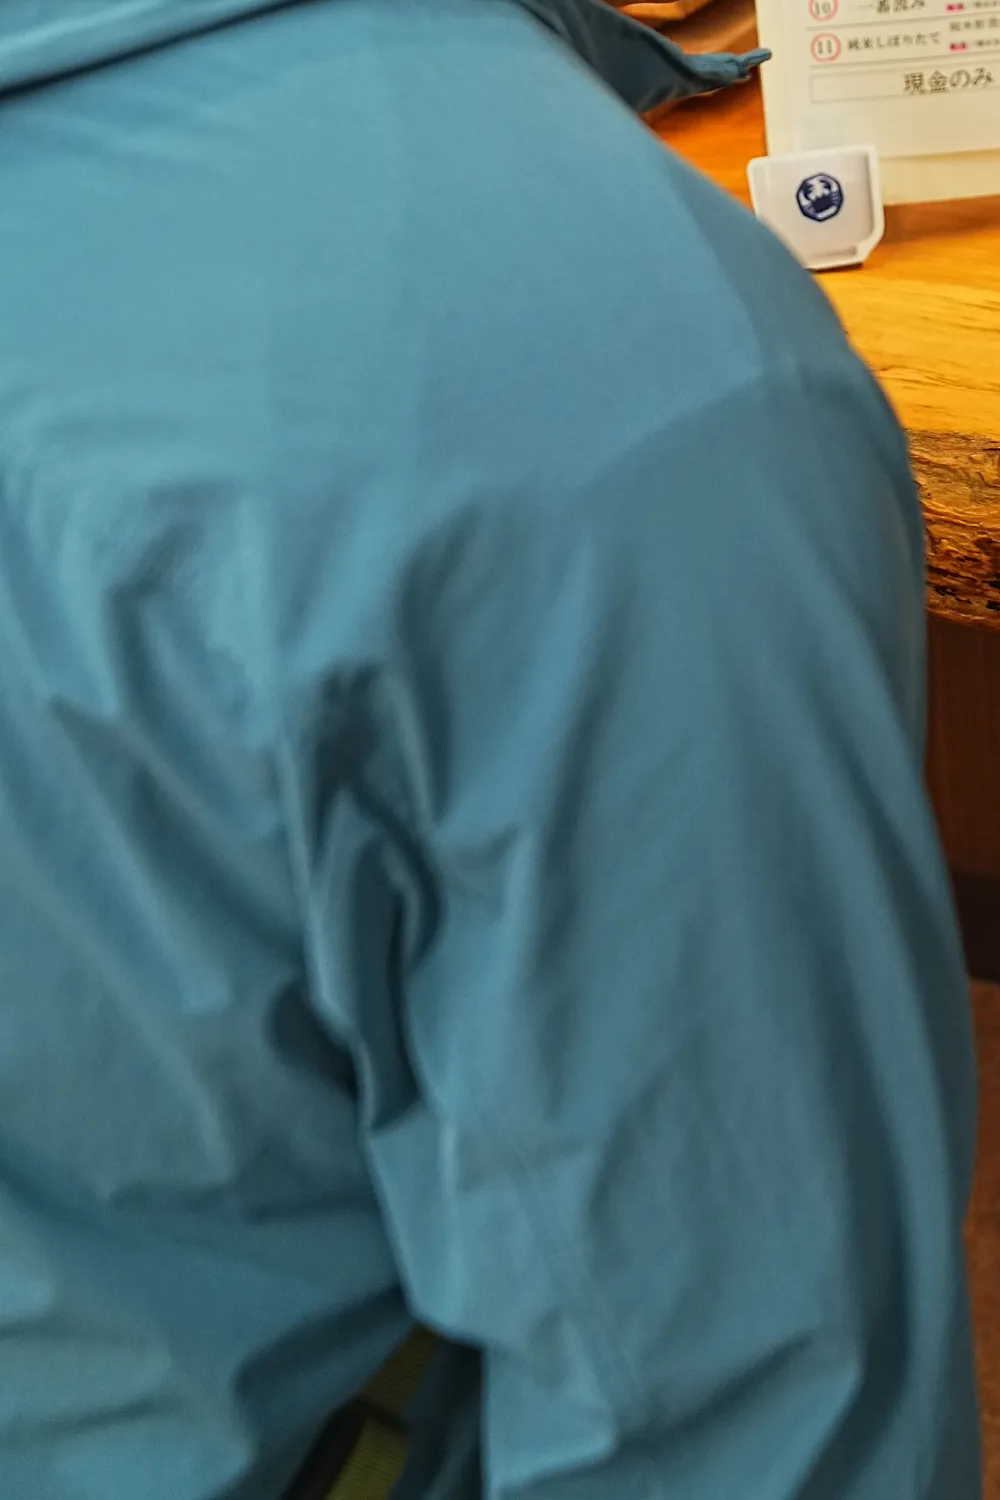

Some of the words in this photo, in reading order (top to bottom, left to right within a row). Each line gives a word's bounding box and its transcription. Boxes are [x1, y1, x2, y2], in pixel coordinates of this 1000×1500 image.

[814, 1, 831, 16] 10
[817, 39, 833, 54] 11
[848, 32, 940, 51] 純米しぼりたて
[904, 68, 993, 96] 現金のみ
